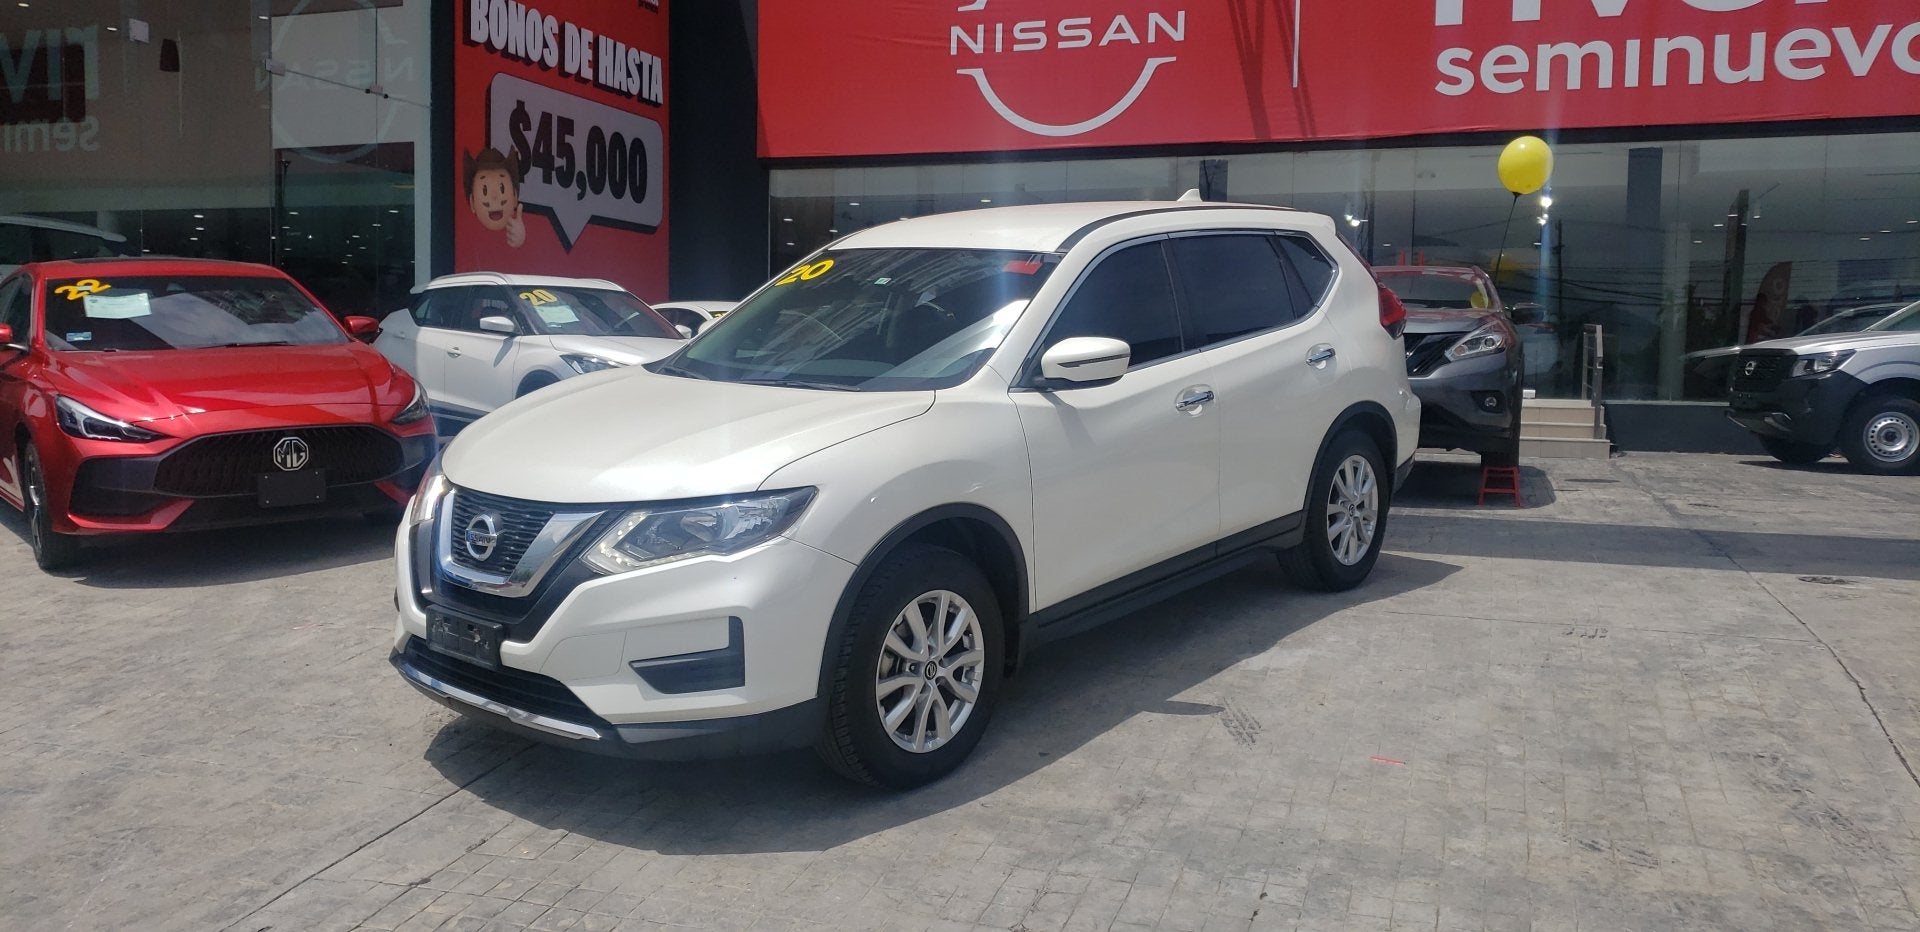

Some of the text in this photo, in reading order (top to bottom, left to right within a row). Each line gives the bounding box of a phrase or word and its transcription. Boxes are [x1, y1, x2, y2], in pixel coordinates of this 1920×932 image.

[950, 11, 1186, 56] NISSAN
[470, 0, 664, 105] BONOS DE HASTA
[508, 100, 648, 205] $45,000
[774, 259, 835, 287] 20
[54, 279, 112, 301] 22
[519, 289, 558, 306] 20
[276, 440, 306, 468] MG
